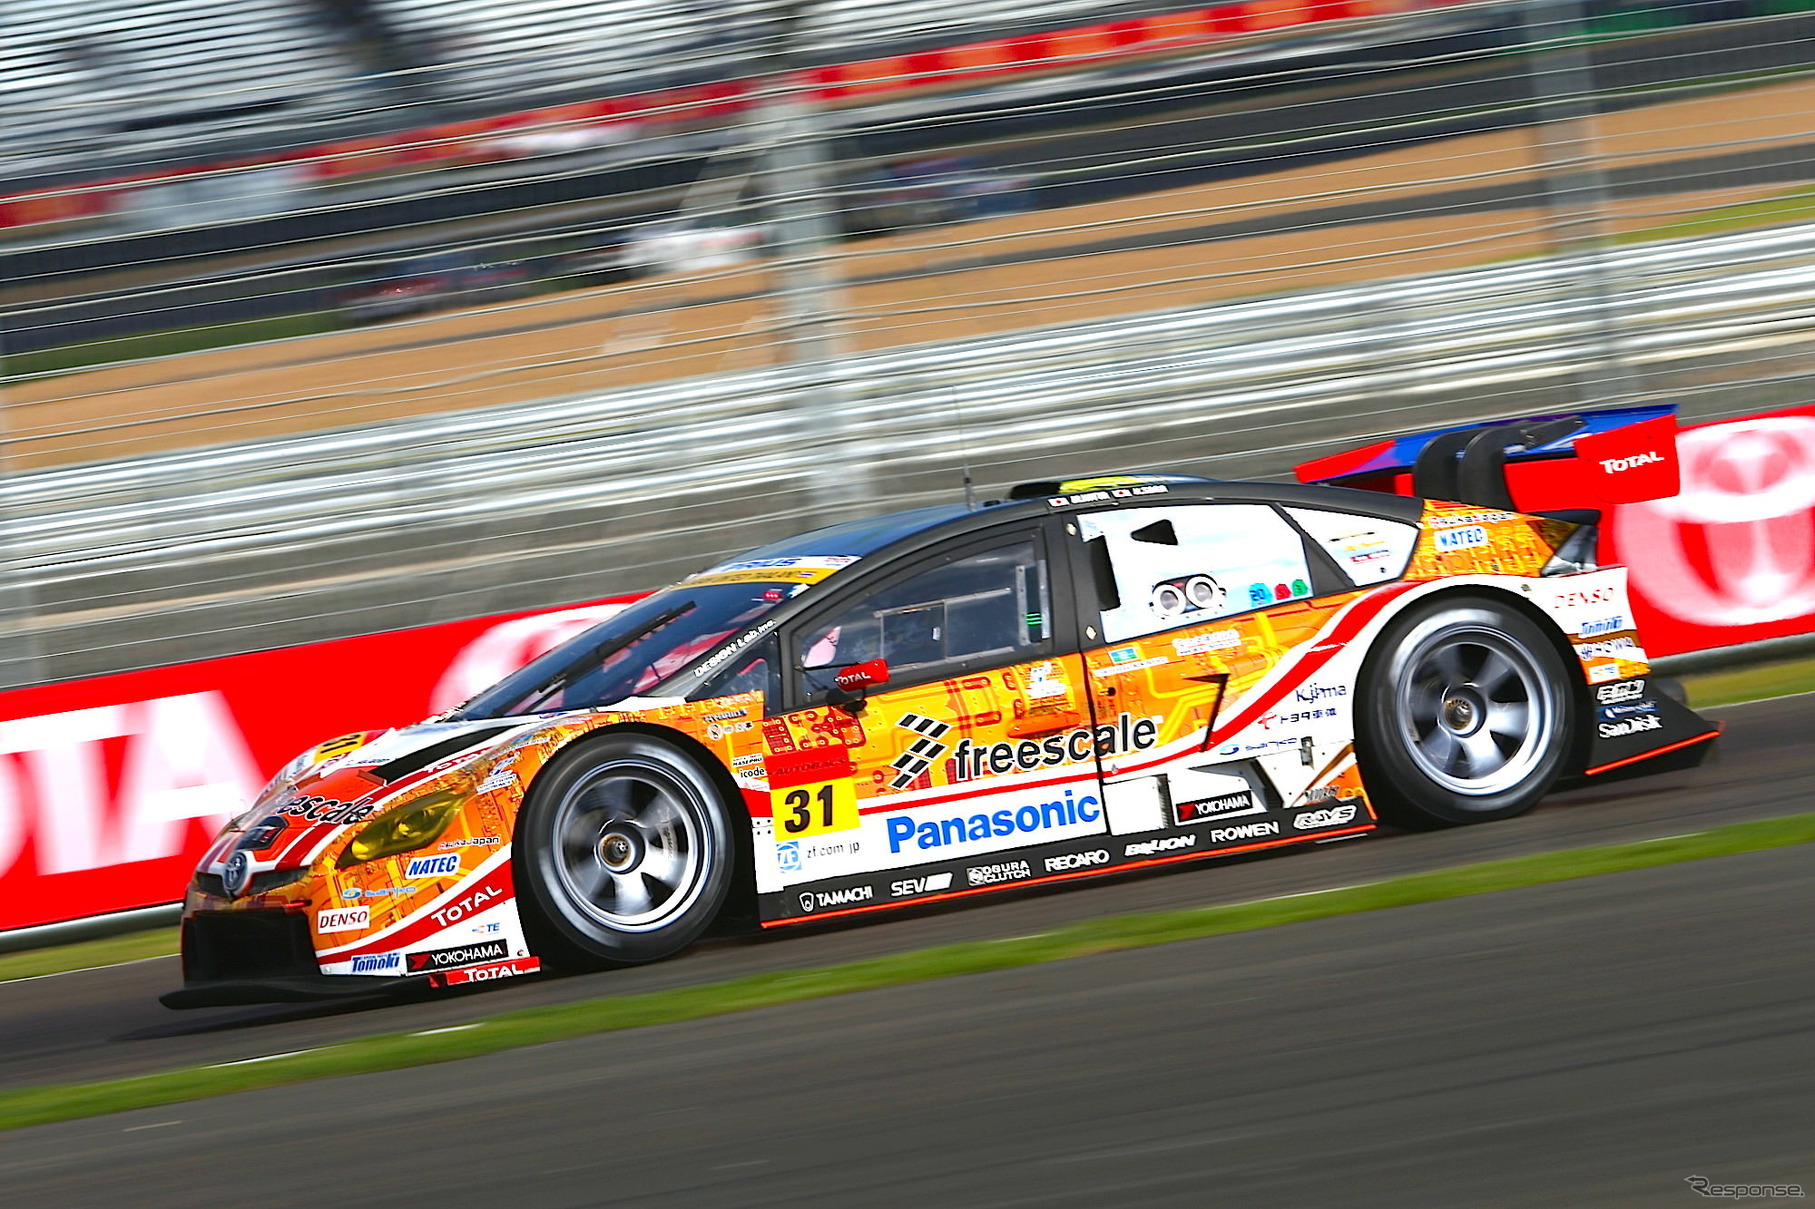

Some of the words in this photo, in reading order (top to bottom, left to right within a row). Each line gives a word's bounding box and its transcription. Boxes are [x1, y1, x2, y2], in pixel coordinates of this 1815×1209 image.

[1599, 451, 1665, 474] TOTAL
[1554, 587, 1614, 609] DENSO
[834, 670, 872, 685] TOTAL
[1599, 714, 1663, 738] SanDisk
[955, 713, 1157, 779] freescale
[740, 767, 765, 778] icode
[784, 784, 834, 834] 31
[1195, 792, 1251, 816] YOKOHAMA
[886, 789, 1101, 854] Panasonic
[1293, 805, 1357, 829] RAYS
[1210, 820, 1280, 844] ROWEN
[408, 856, 458, 877] NATEC
[982, 860, 1029, 875] OGURA
[1044, 850, 1110, 872] RECARO
[982, 868, 1031, 883] CLUTCH
[815, 885, 874, 907] TAMACHI
[889, 877, 928, 897] SEV
[431, 884, 503, 927] TOTAL
[319, 910, 368, 929] DENSO
[486, 922, 501, 933] TE
[351, 954, 400, 973] Tomoki
[431, 944, 504, 966] YOKOHAMA
[464, 963, 525, 983] TOTAL
